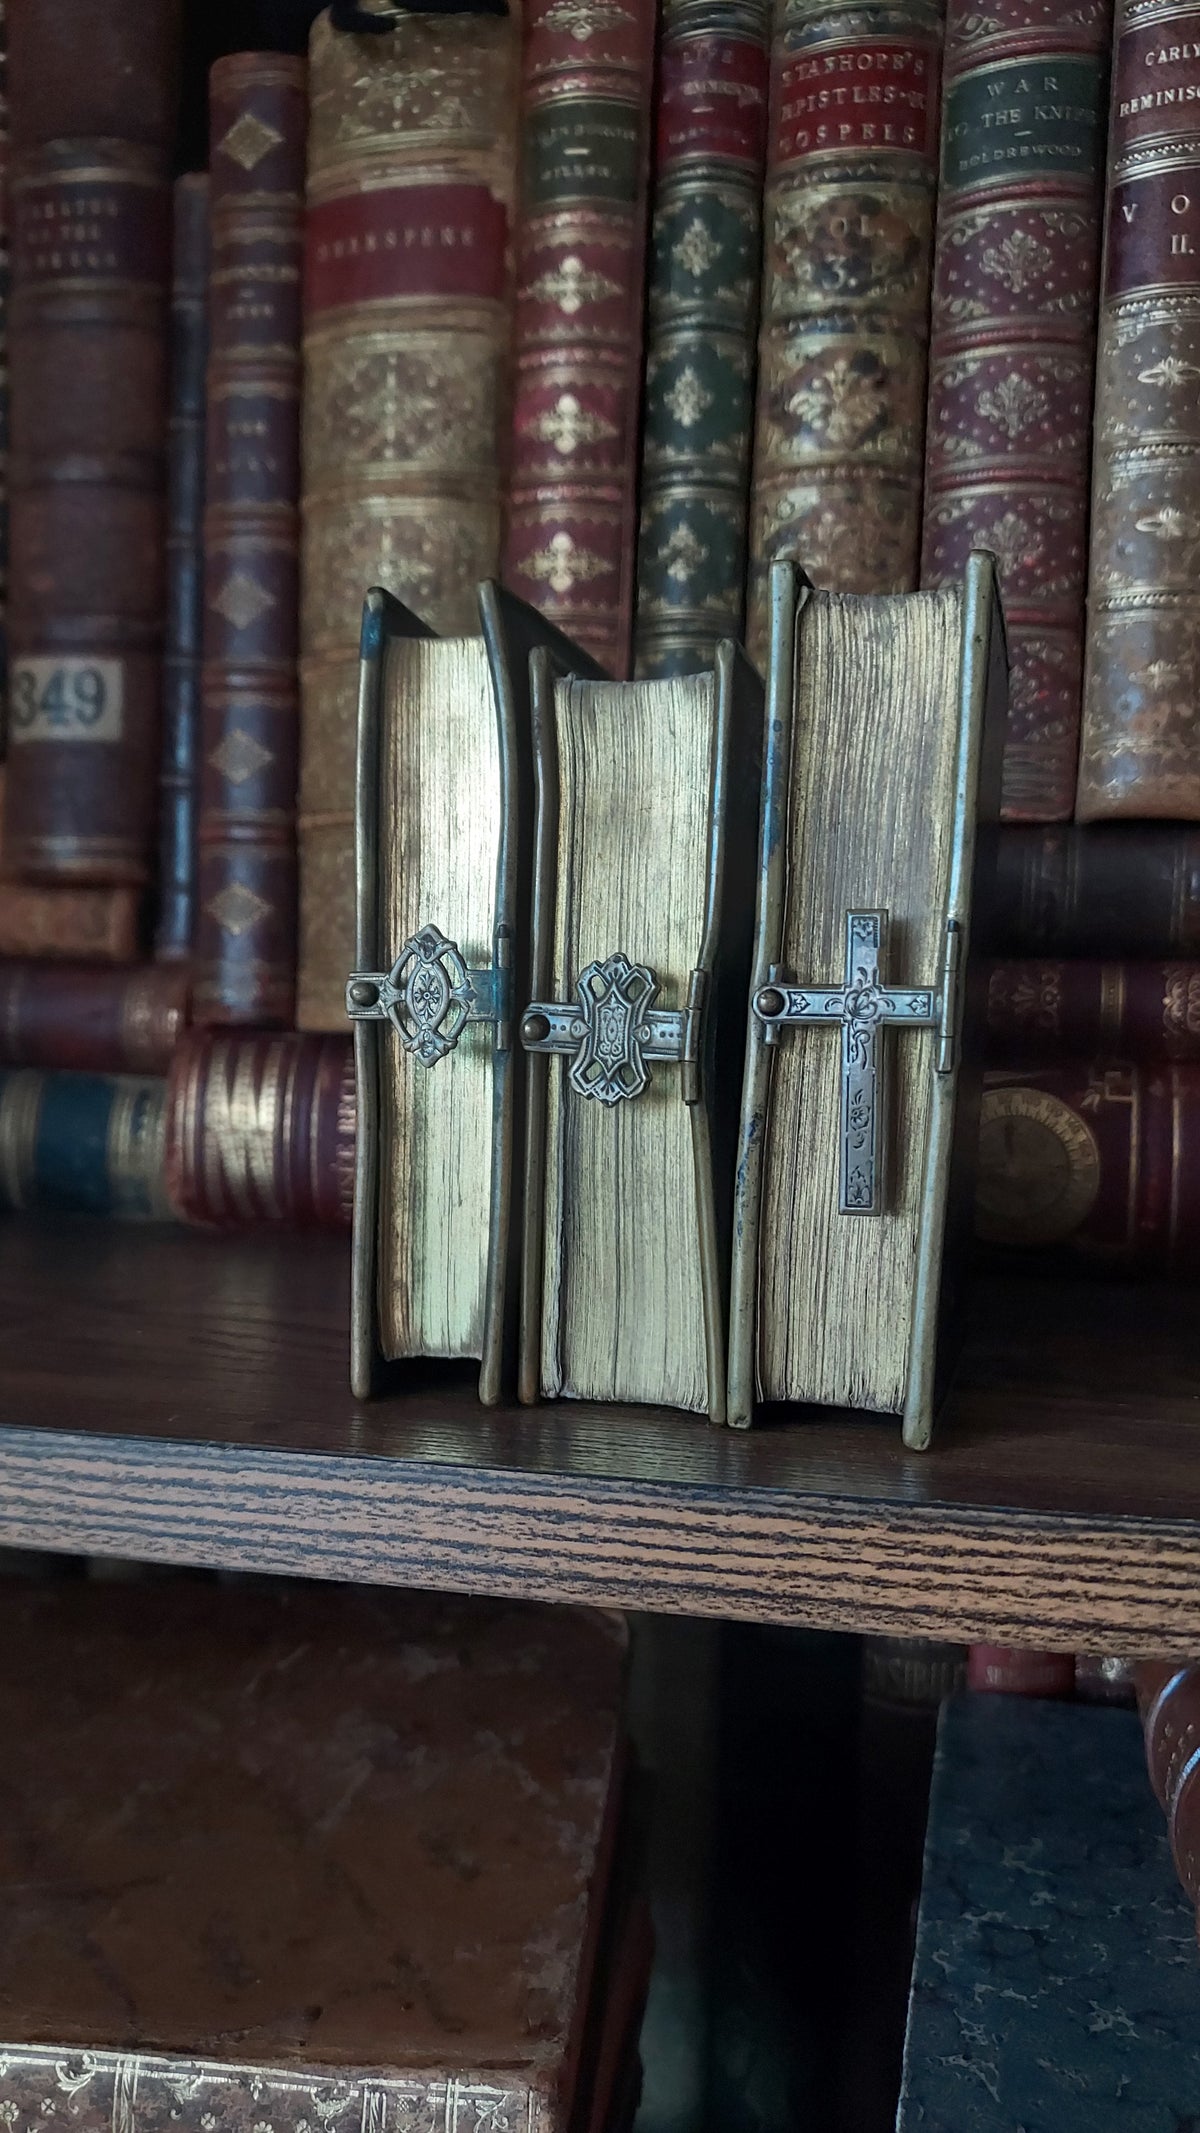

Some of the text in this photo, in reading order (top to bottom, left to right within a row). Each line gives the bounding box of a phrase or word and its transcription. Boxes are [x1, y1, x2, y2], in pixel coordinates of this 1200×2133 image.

[987, 76, 1059, 97] WAR
[981, 108, 1021, 129] THE
[13, 668, 107, 727] 349
